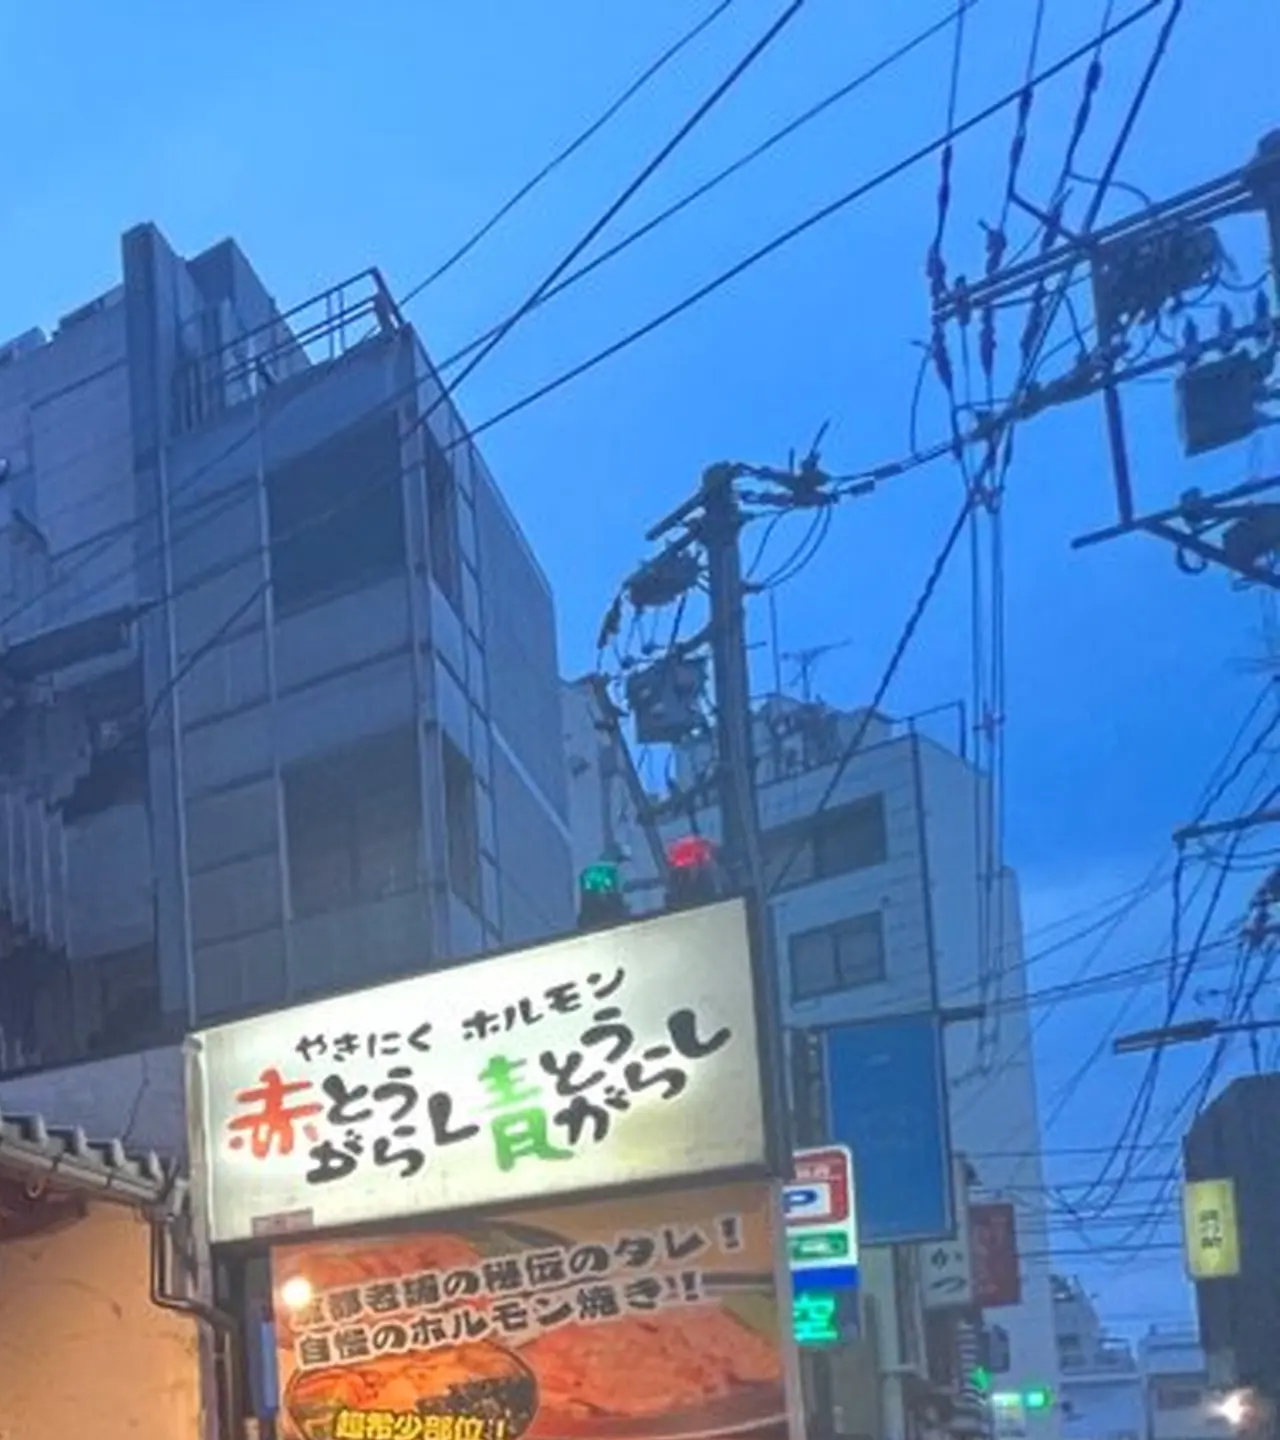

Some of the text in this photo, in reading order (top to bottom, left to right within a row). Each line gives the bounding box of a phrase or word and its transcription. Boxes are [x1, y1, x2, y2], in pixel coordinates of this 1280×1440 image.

[296, 968, 625, 1063] やきにく ホルモン
